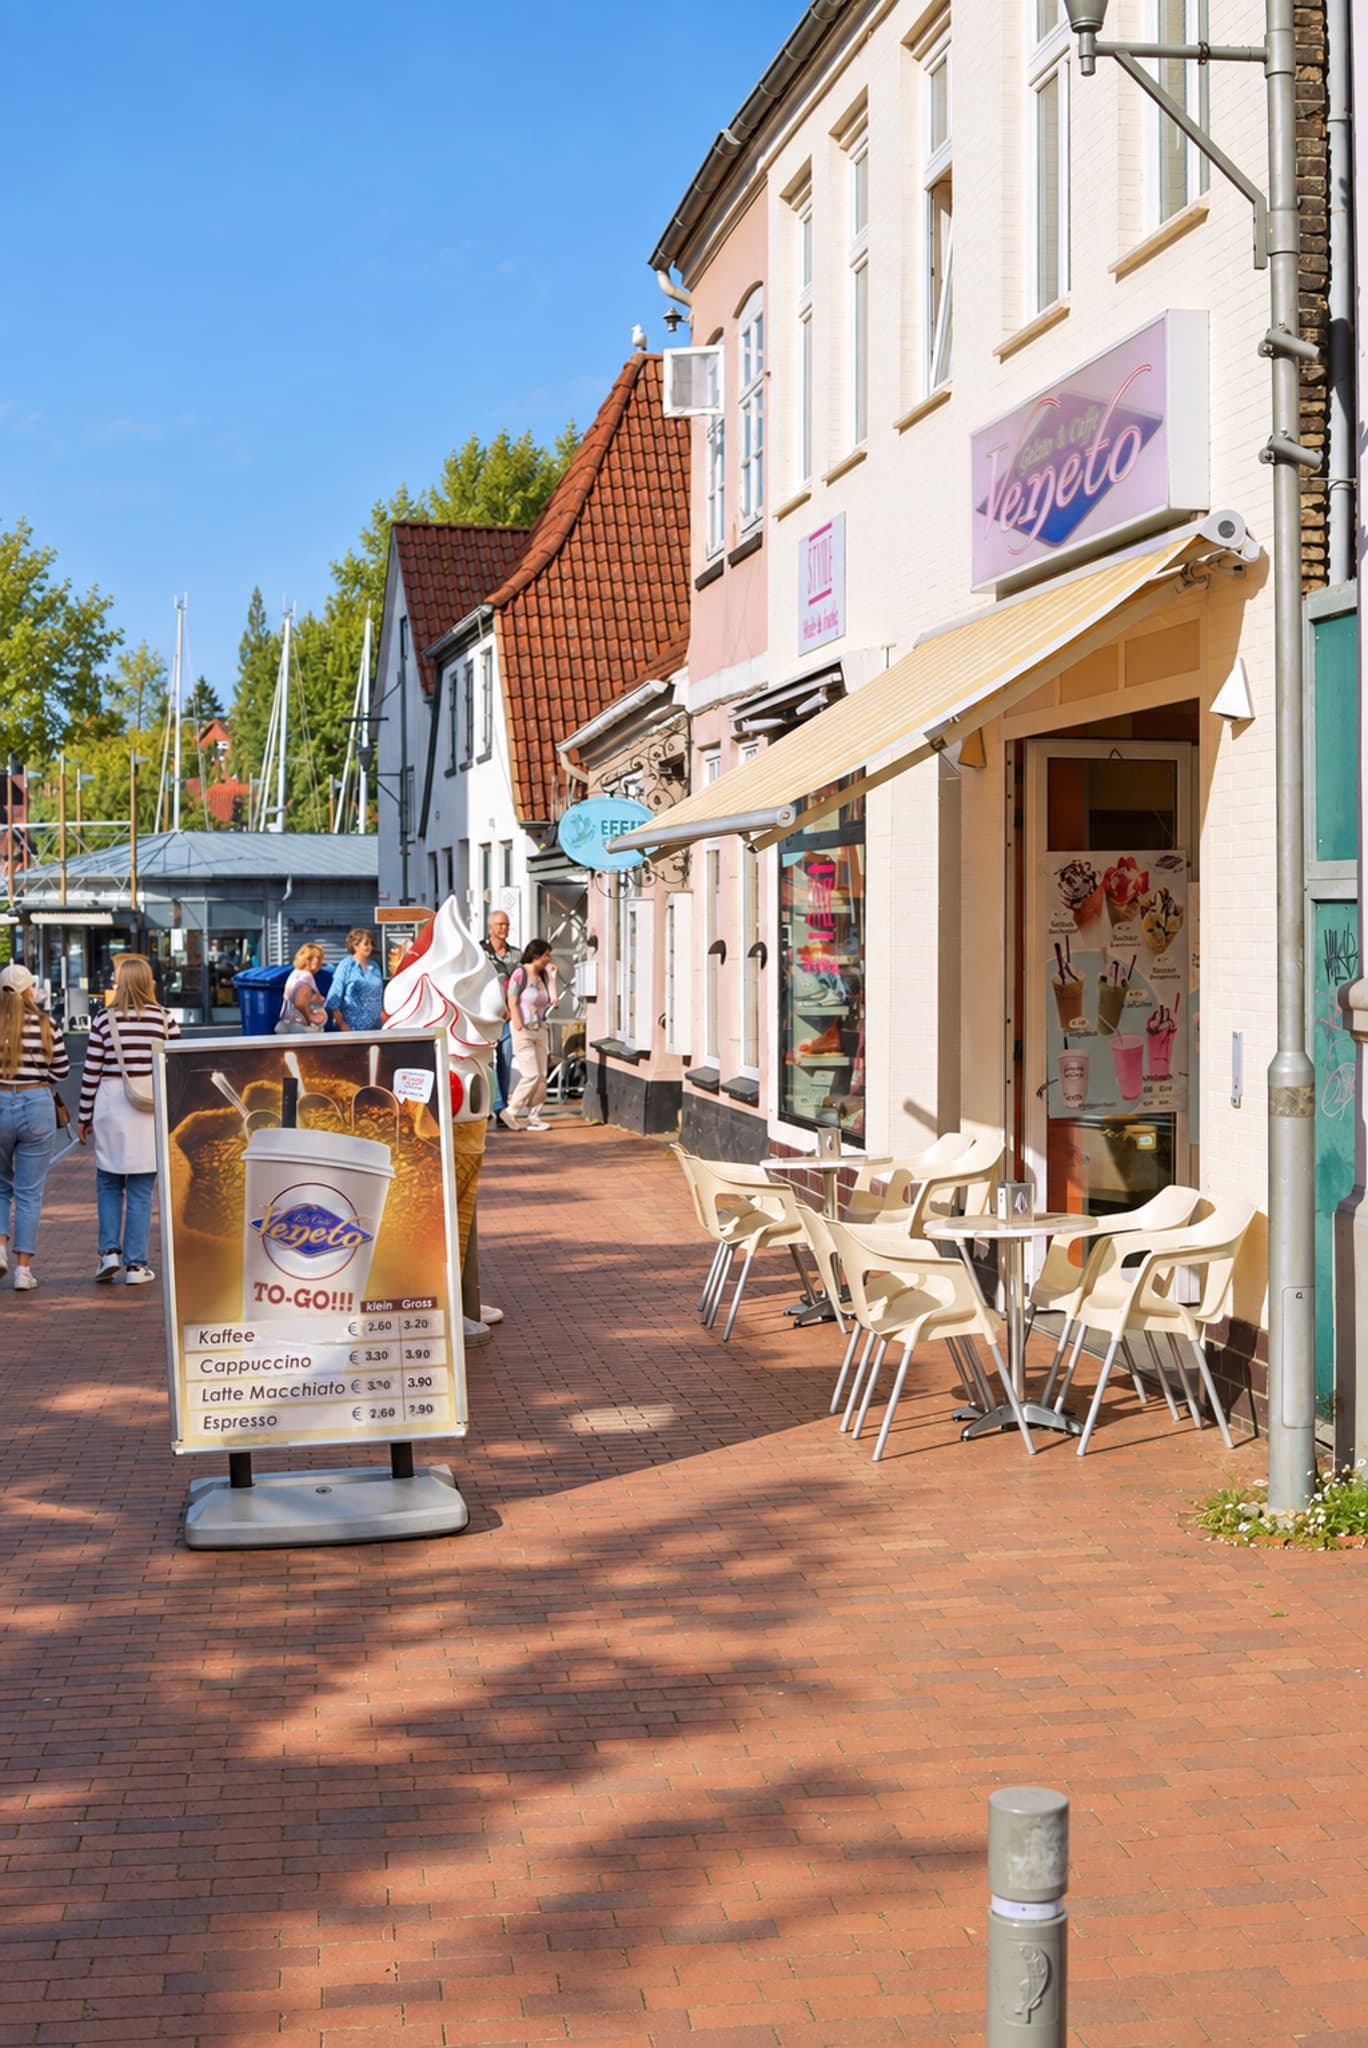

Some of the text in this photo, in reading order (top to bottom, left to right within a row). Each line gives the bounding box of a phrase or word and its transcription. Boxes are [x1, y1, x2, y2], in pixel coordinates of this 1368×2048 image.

[984, 363, 1152, 556] Veneto
[258, 1204, 369, 1249] Veneto
[254, 1282, 354, 1311] TO-GO!!!
[366, 1298, 433, 1312] klein Gross
[199, 1329, 256, 1345] Kaffee
[348, 1321, 358, 1337] €
[200, 1354, 312, 1375] Cappuccino
[350, 1350, 360, 1366] €
[202, 1387, 244, 1402] Latte
[250, 1382, 346, 1400] Macchiato
[351, 1379, 361, 1394] €
[408, 1377, 432, 1388] 3.90
[203, 1413, 278, 1432] Espresso
[352, 1406, 362, 1422] €
